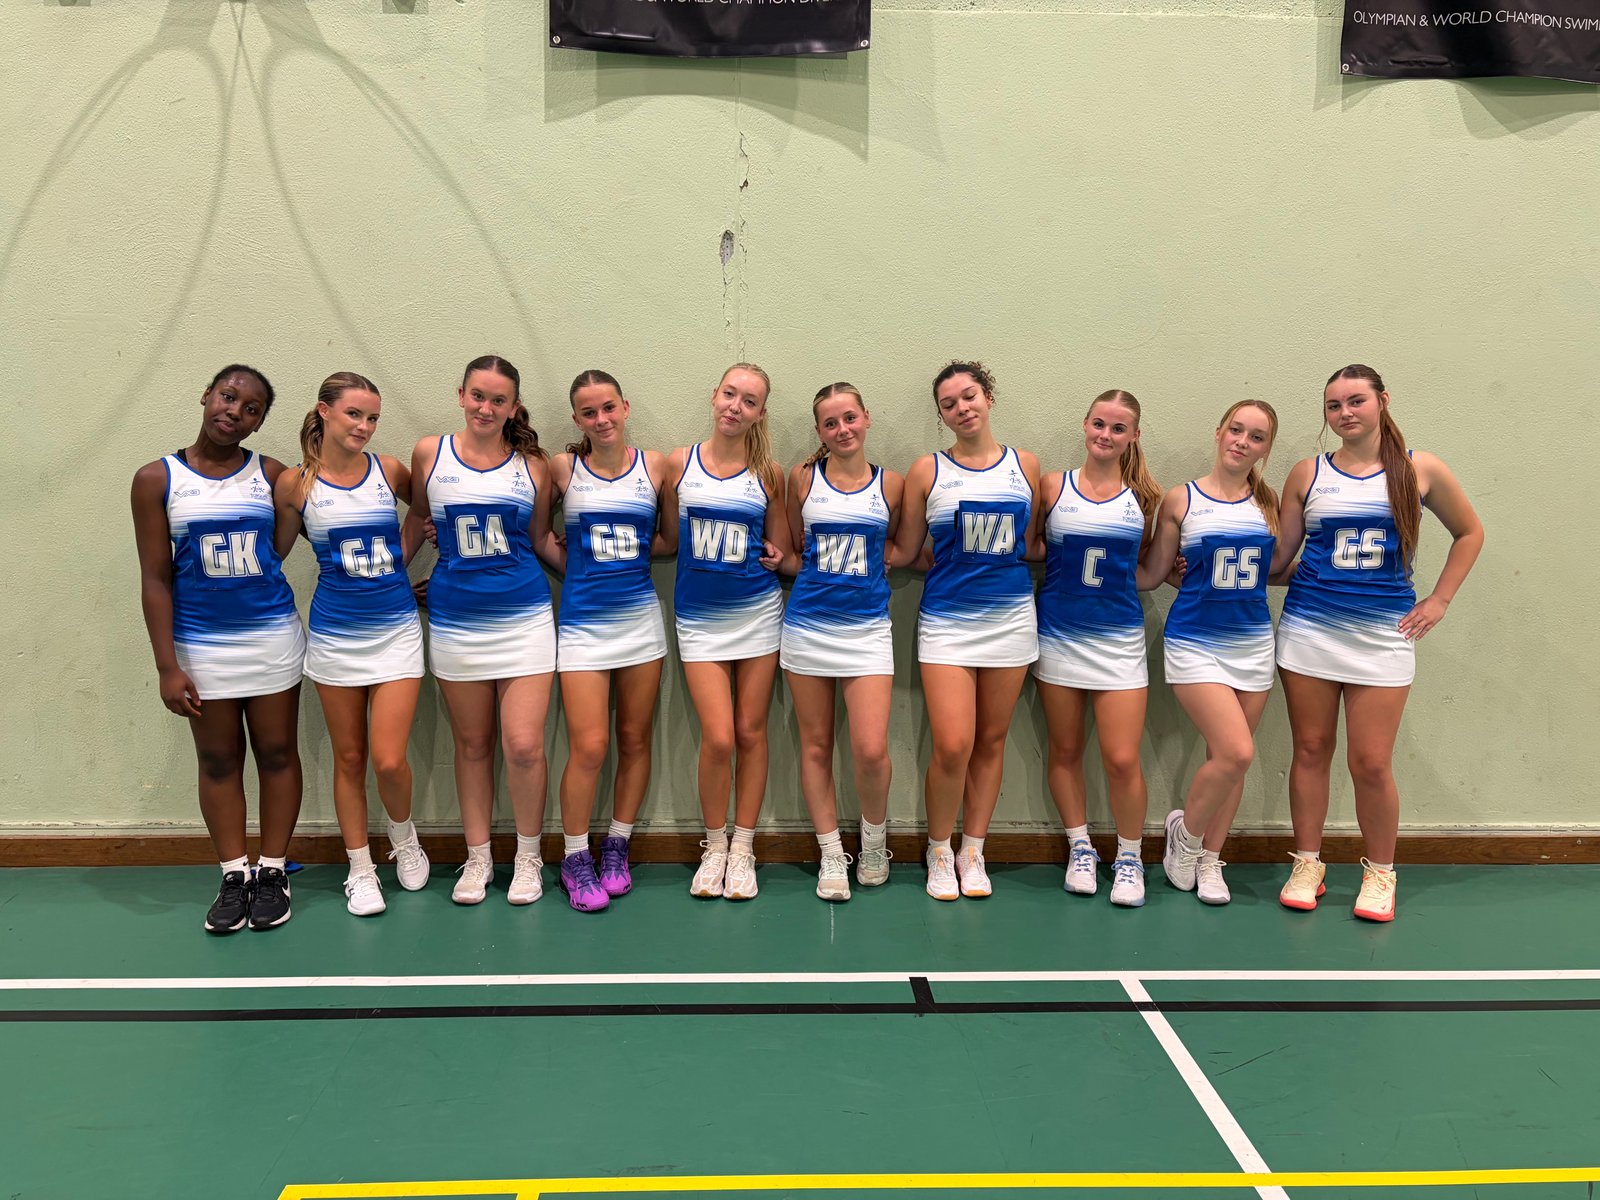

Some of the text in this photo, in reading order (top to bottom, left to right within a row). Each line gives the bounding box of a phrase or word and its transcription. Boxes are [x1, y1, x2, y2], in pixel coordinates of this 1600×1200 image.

[1353, 10, 1600, 31] OLYMPIAN & WORLD CHAMPION SWIM
[200, 531, 264, 578] GK
[455, 514, 511, 559] GA
[589, 523, 640, 563] GD
[690, 517, 749, 564] WD
[816, 533, 868, 577] WA
[961, 511, 1016, 556] WA
[1331, 527, 1386, 570] GS
[340, 537, 396, 579] GA
[1083, 547, 1107, 588] C
[1211, 546, 1262, 590] GS
